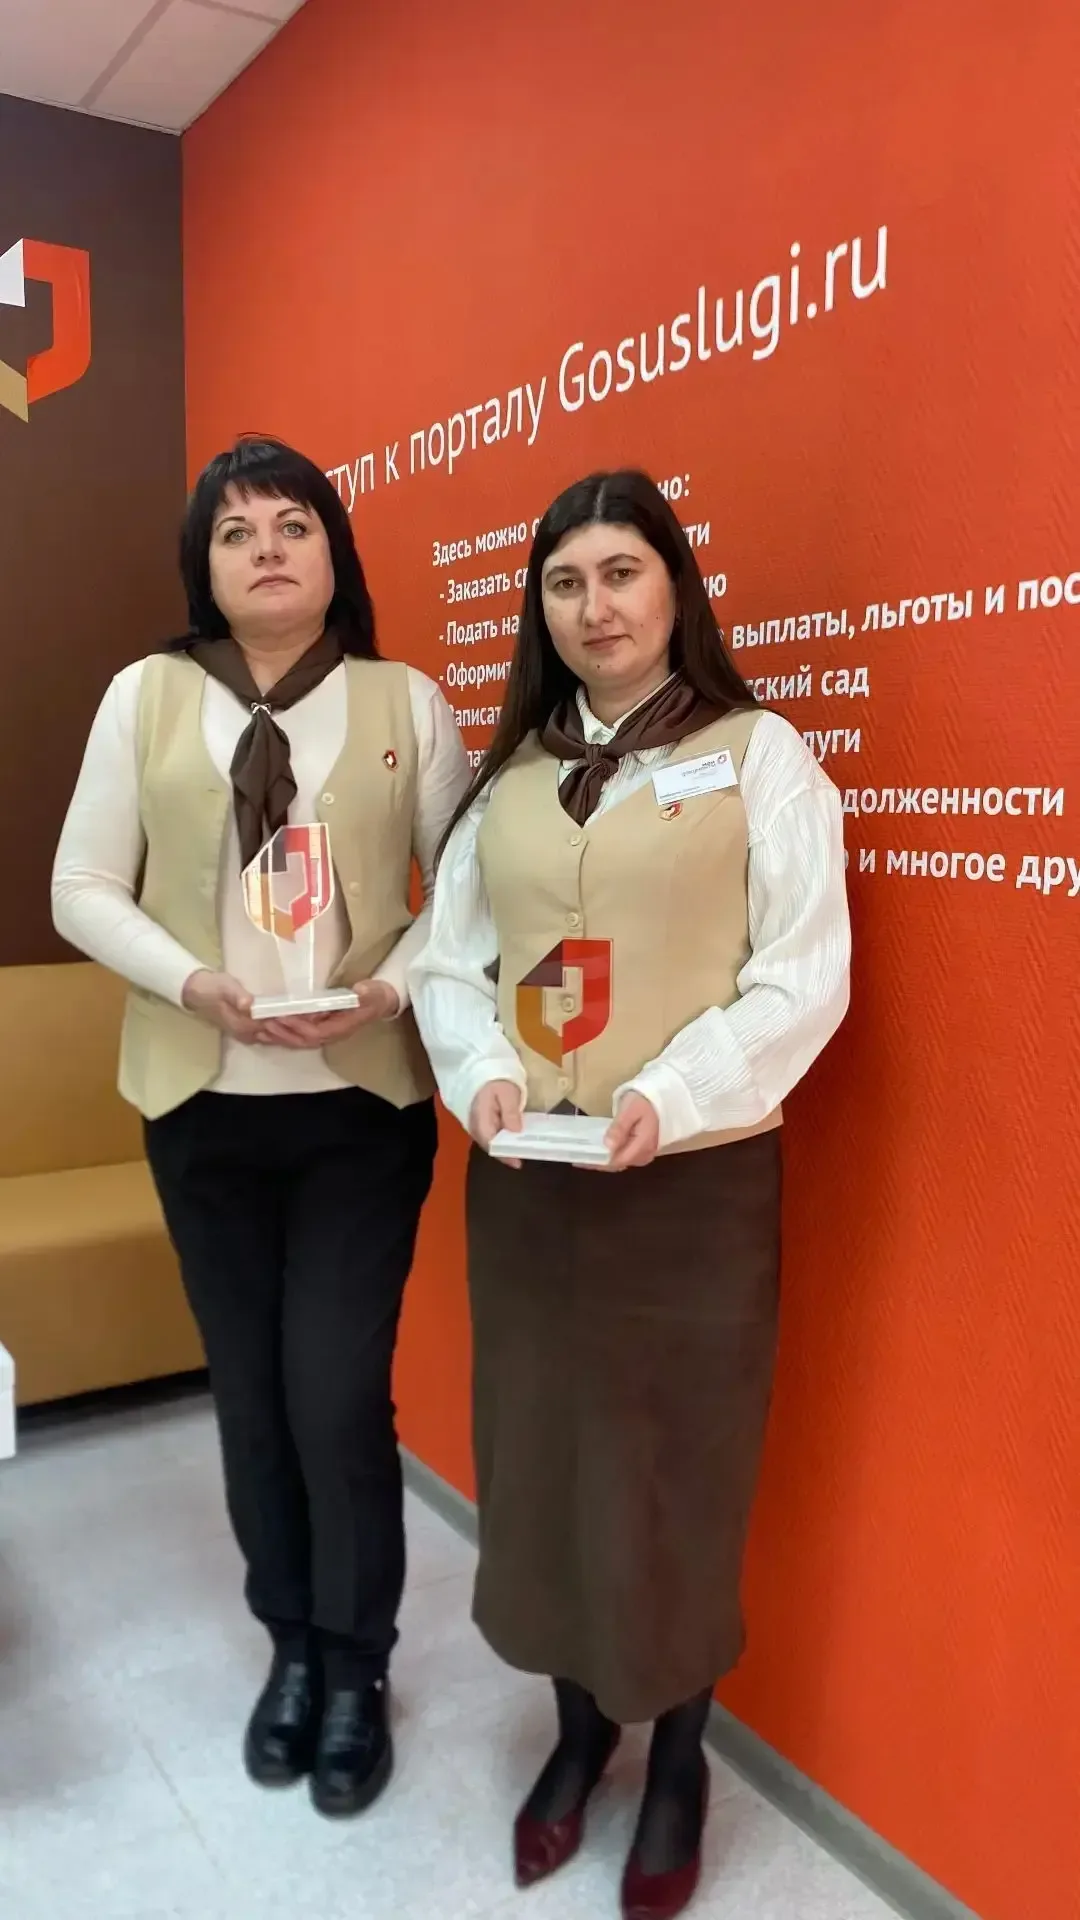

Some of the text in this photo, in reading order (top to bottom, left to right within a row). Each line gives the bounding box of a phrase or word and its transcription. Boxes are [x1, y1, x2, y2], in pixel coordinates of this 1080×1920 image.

[325, 225, 888, 514] туп к порталу Gosuslugi.ru
[432, 540, 472, 567] Здесь
[475, 522, 527, 554] можно
[446, 573, 511, 604] Заказать
[682, 521, 710, 548] ти
[446, 620, 498, 646] Подать
[732, 609, 855, 649] выплаты,
[860, 590, 973, 632] льготы
[984, 584, 1005, 615] и
[821, 667, 870, 699] сад
[859, 848, 876, 873] и
[886, 849, 1006, 882] многое
